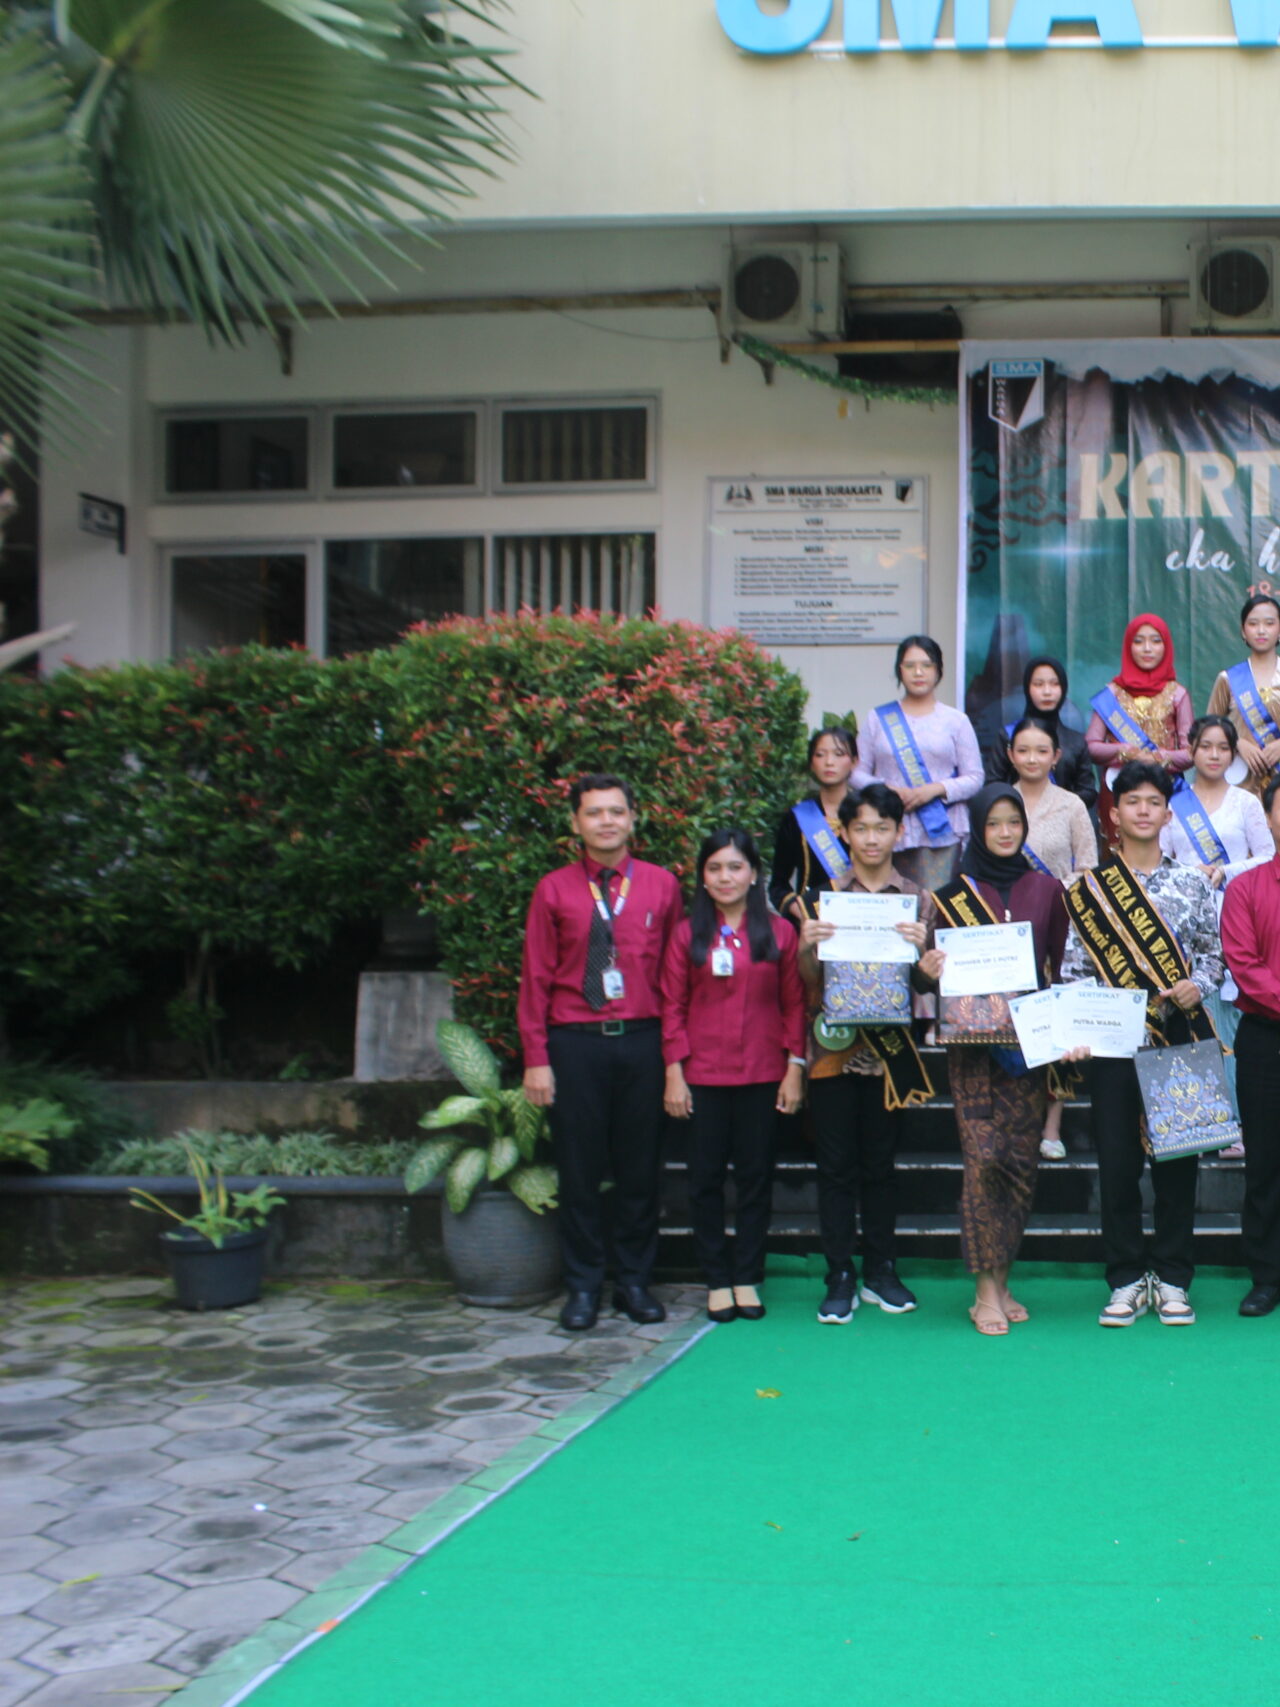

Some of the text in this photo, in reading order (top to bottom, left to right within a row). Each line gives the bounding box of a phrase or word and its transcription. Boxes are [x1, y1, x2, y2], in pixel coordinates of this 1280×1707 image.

[994, 362, 1039, 375] SMA
[765, 485, 883, 496] SMA WARGA SURAKARTA
[1101, 865, 1138, 912] PUTRA
[1128, 907, 1158, 942] SMA
[1149, 936, 1181, 985] WARG
[1104, 943, 1128, 976] SMA
[1073, 1018, 1122, 1027] PUTRA WARGA
